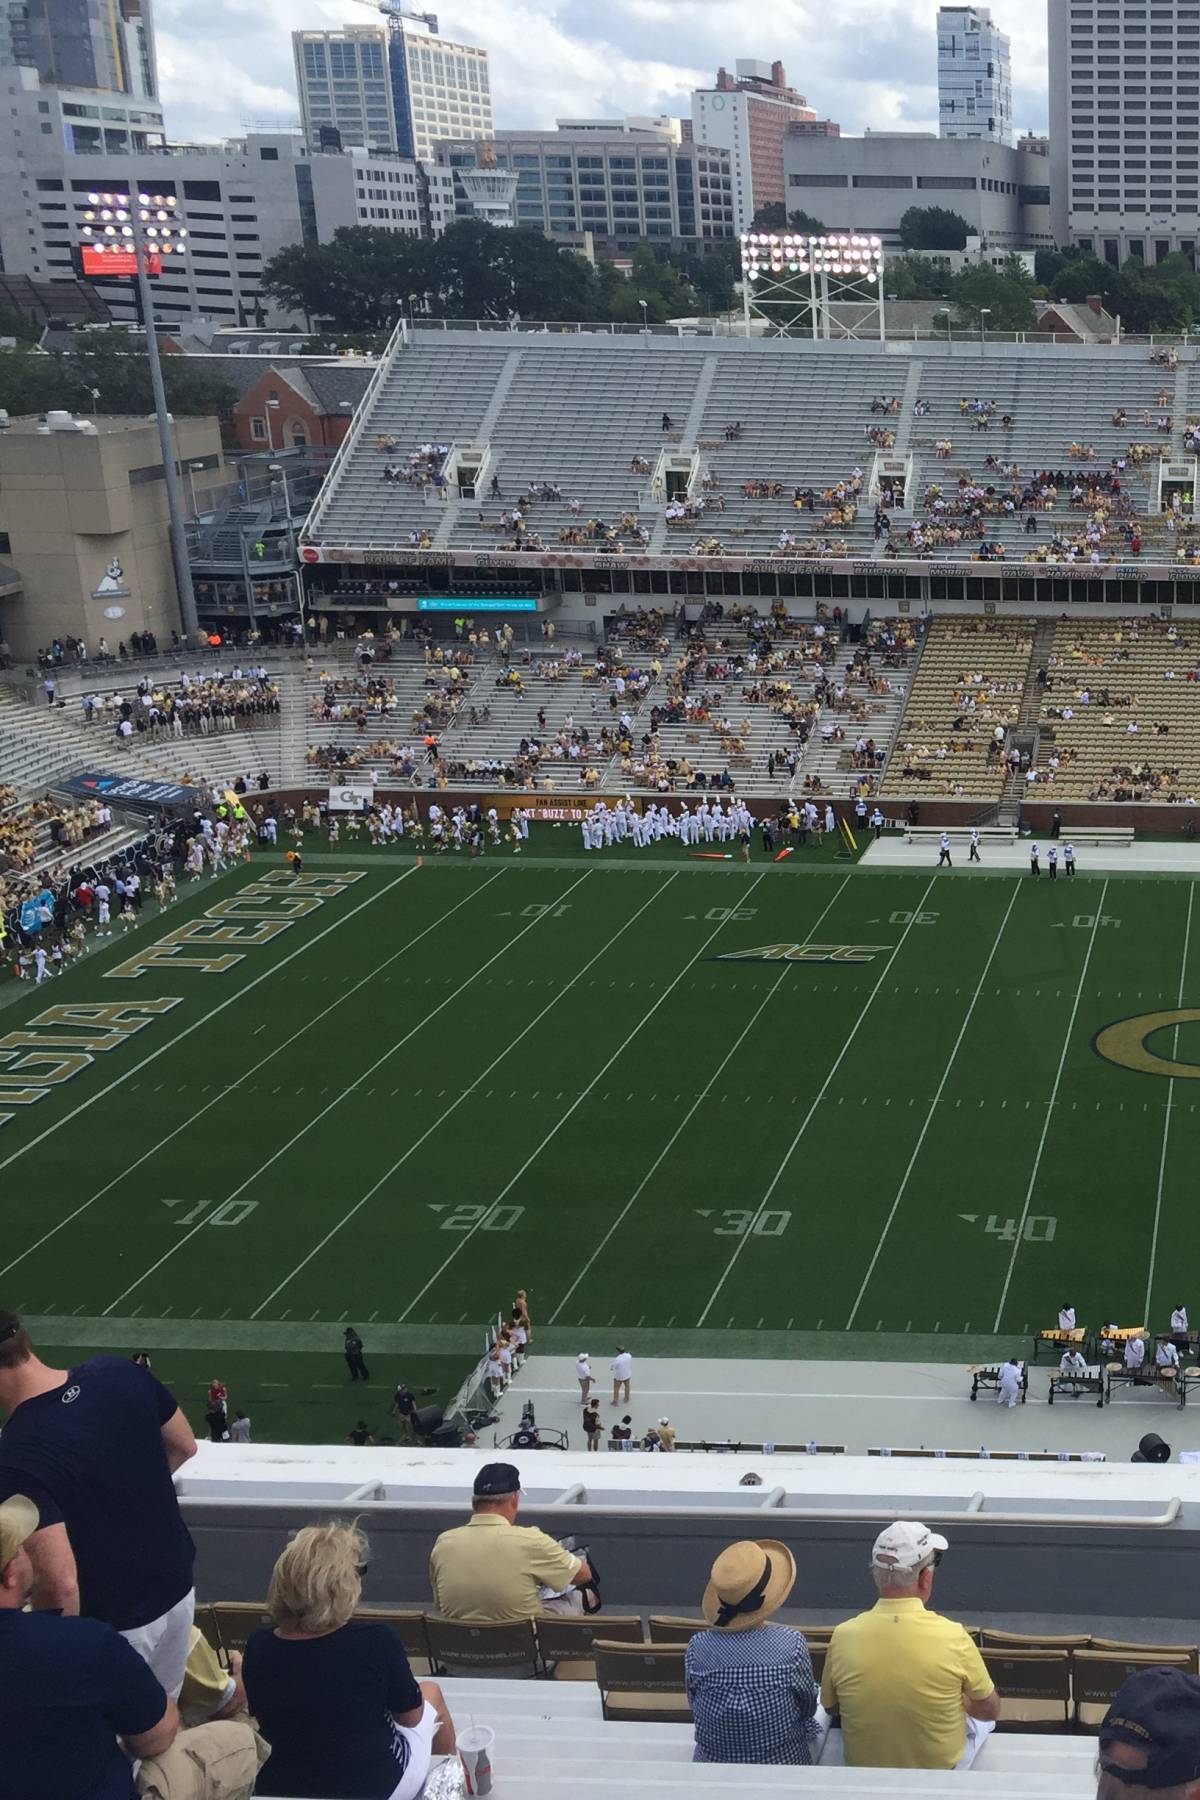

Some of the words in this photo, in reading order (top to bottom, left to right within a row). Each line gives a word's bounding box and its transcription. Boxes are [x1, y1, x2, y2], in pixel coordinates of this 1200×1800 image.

[102, 870, 367, 978] TECH
[888, 911, 940, 925] 30
[1072, 915, 1121, 929] 40
[718, 943, 893, 961] ACC
[174, 1200, 259, 1226] 10
[440, 1204, 526, 1231] 20
[713, 1209, 792, 1236] 30
[984, 1214, 1058, 1241] 40
